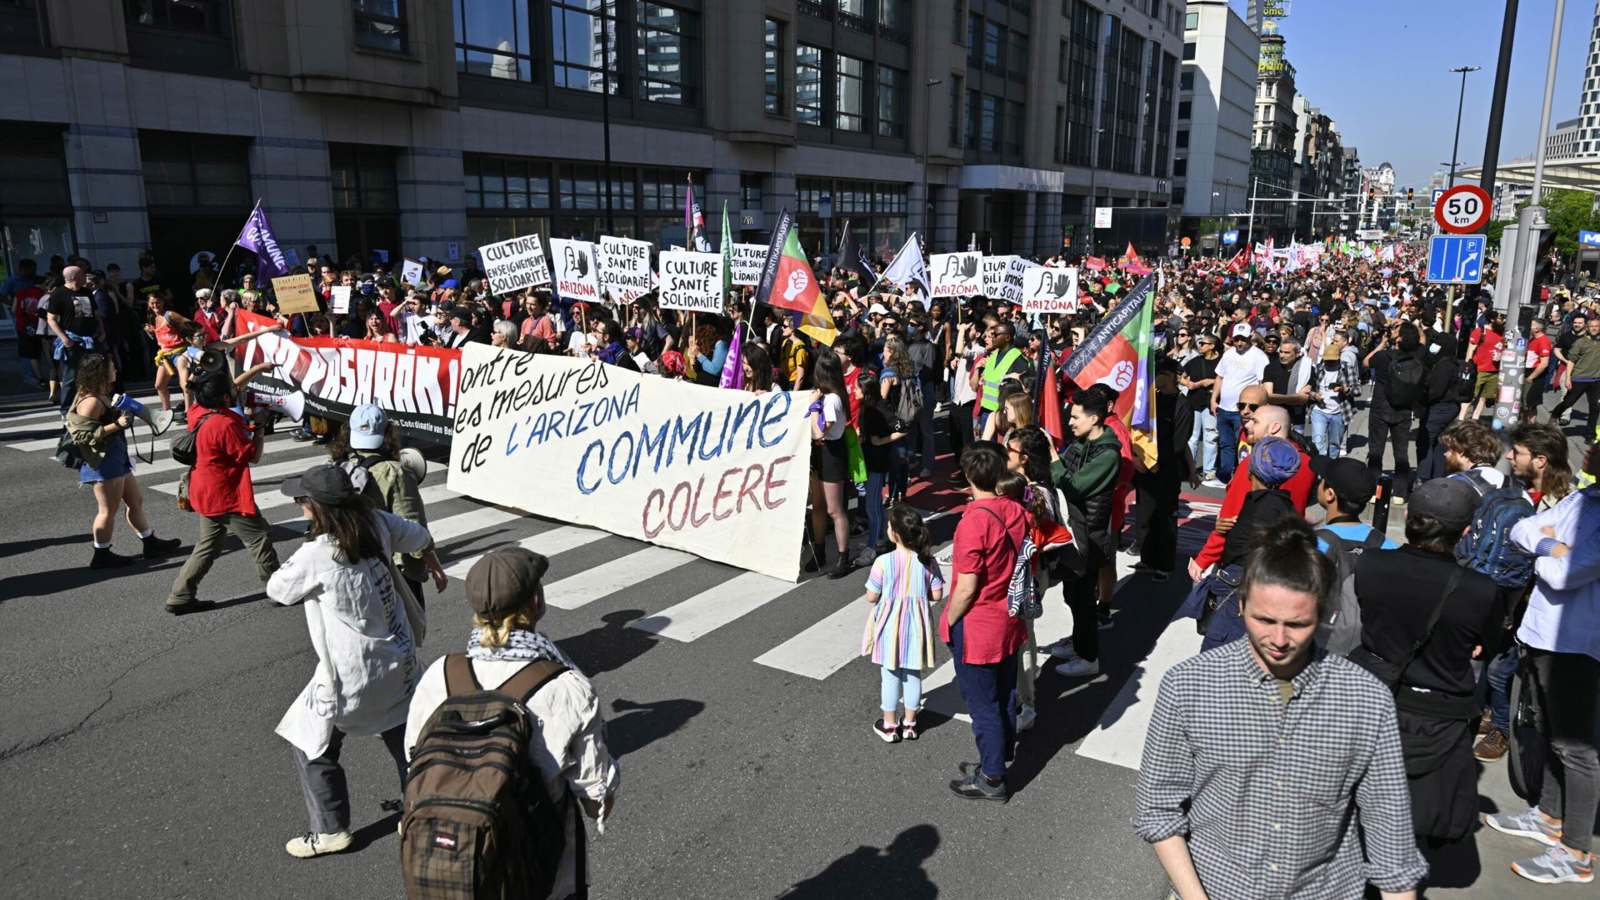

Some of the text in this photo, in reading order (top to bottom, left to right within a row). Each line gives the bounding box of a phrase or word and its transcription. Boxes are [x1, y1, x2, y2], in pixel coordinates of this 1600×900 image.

[1448, 198, 1478, 215] 50
[1454, 216, 1470, 224] km
[486, 236, 540, 261] CULTURE
[603, 242, 646, 259] CULTURE
[732, 248, 767, 259] ULTURE
[487, 254, 545, 279] ENSEIGNEMENT
[607, 257, 638, 271] SANTÉ
[665, 260, 718, 277] CULTURE
[983, 261, 1006, 272] LTUR
[559, 280, 597, 298] ARIZONA
[670, 275, 709, 293] SANTÉ
[934, 284, 979, 296] ARIZONA
[1026, 300, 1074, 311] ARIZONA
[461, 349, 535, 394] ontre
[455, 362, 609, 434] es mesures
[461, 433, 492, 474] de
[643, 455, 796, 539] COLERE
